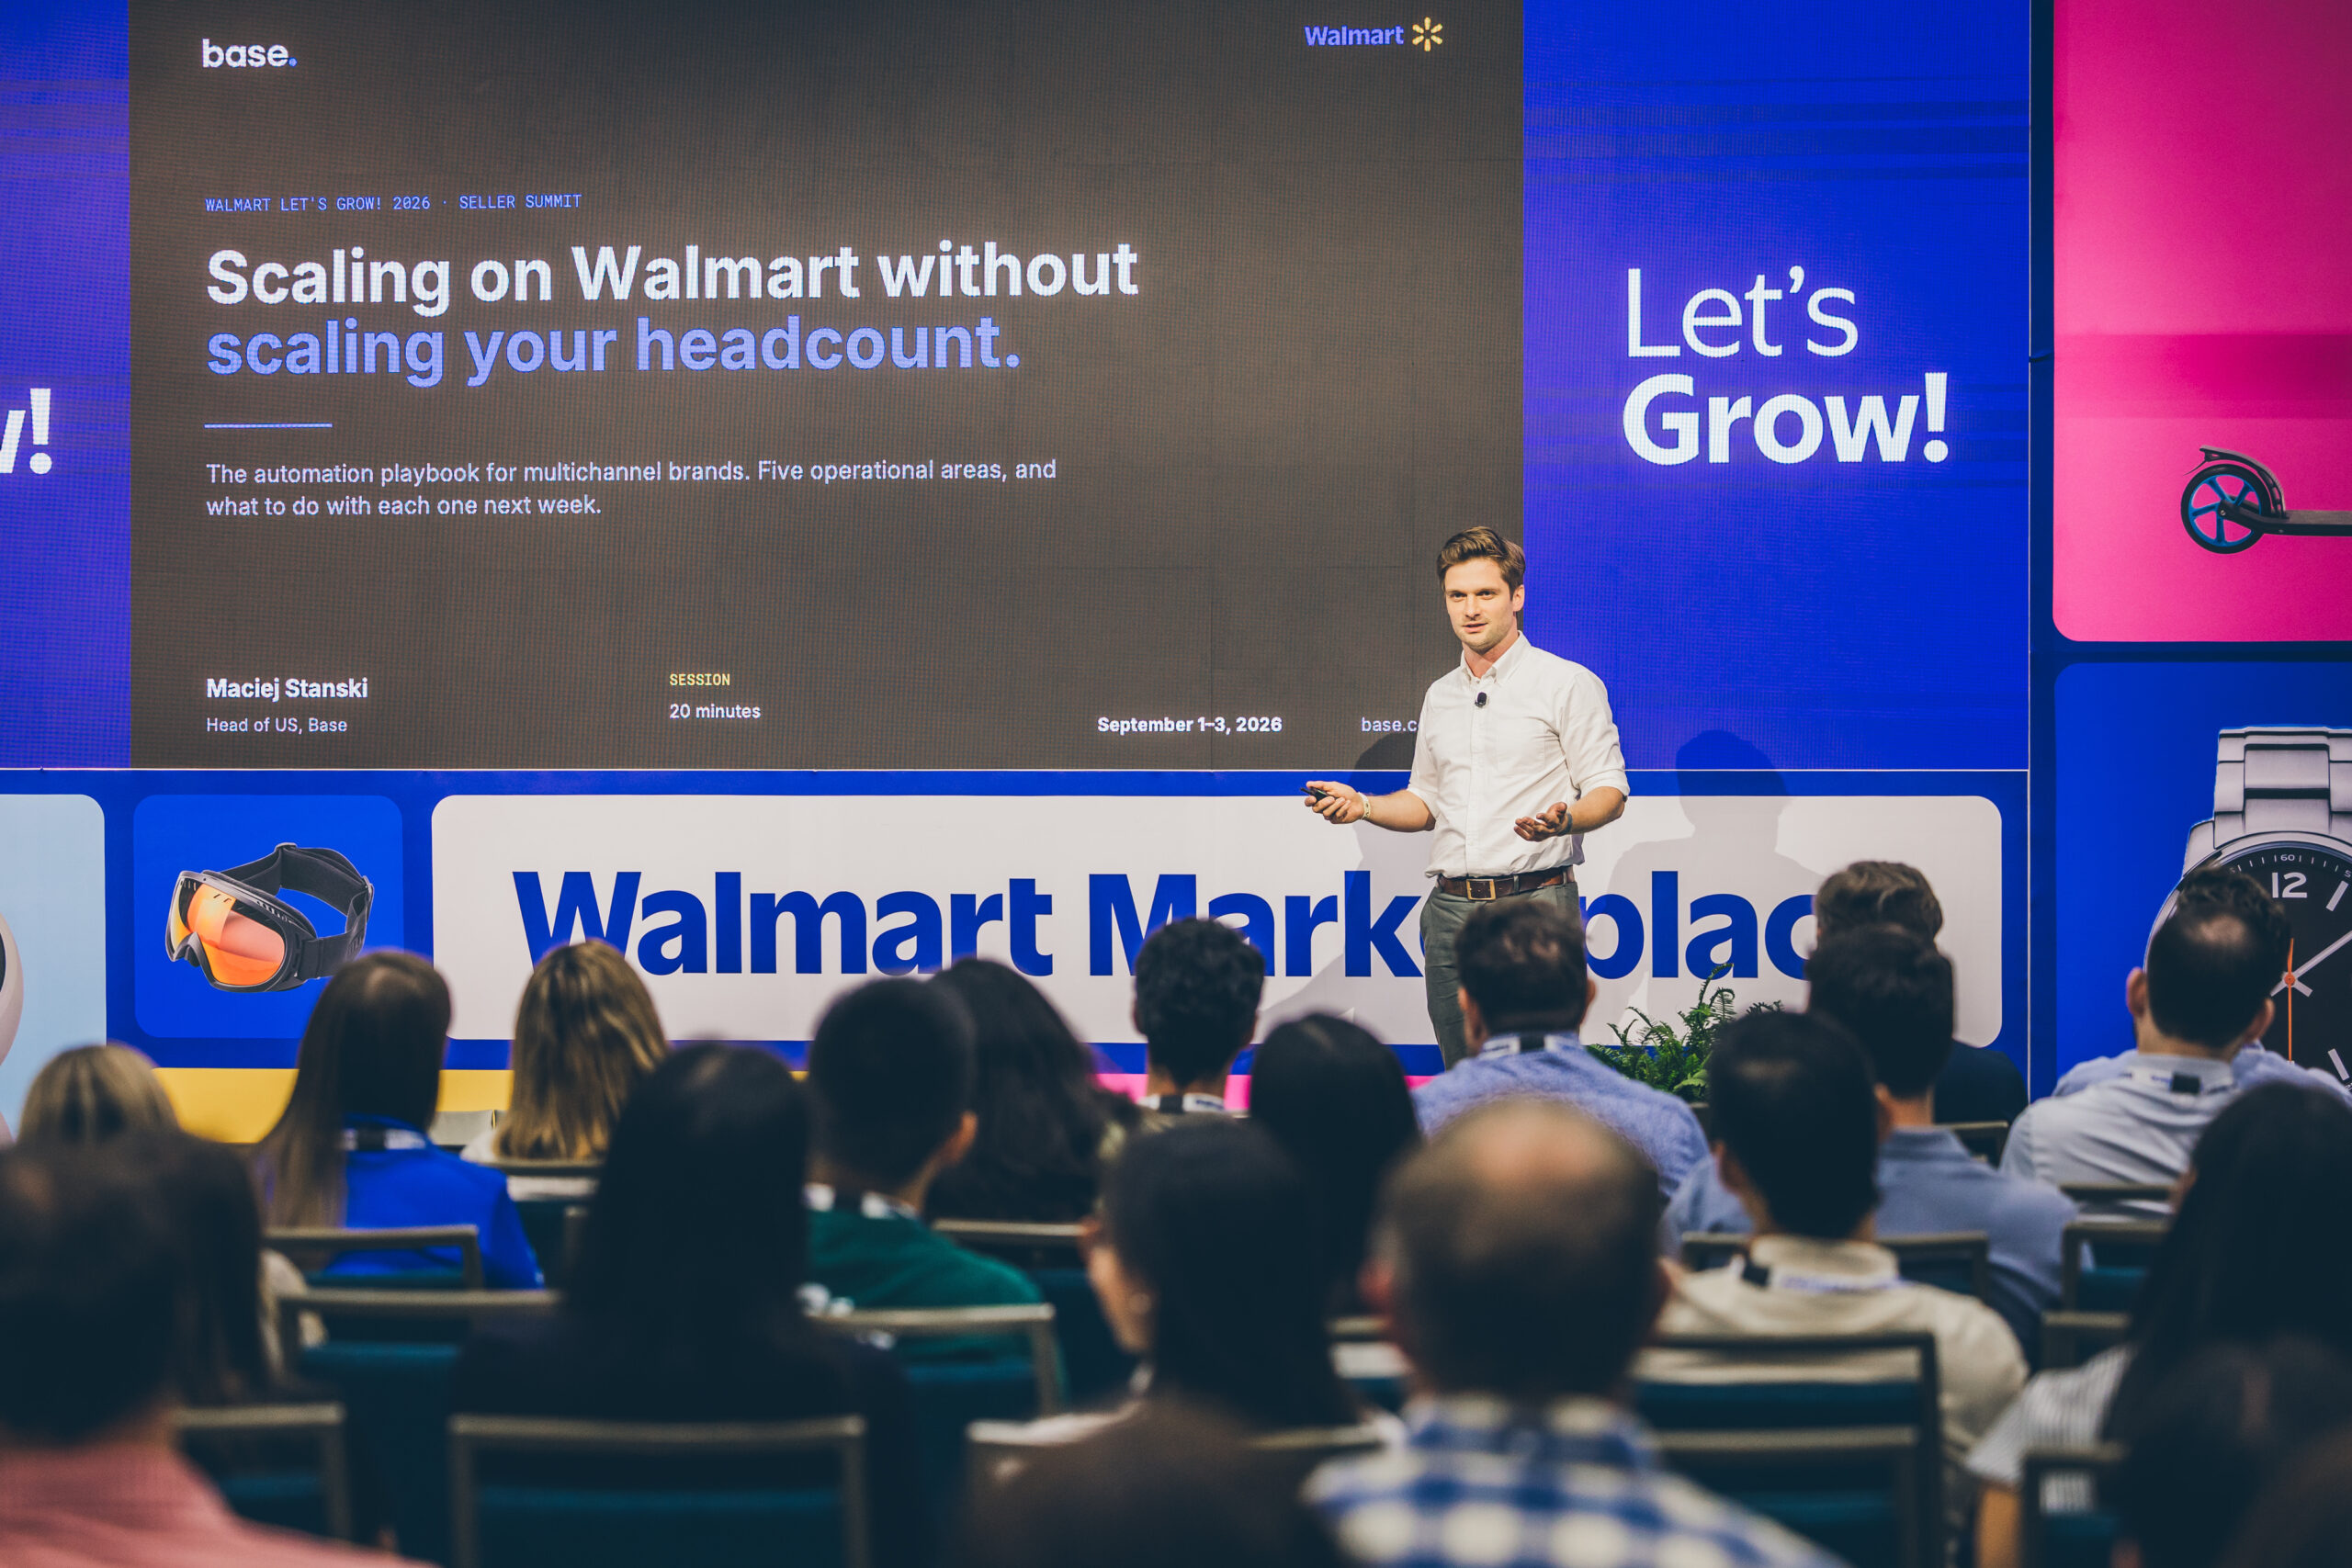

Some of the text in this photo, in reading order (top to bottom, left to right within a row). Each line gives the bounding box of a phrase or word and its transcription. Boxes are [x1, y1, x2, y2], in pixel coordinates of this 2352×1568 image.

[1304, 25, 1405, 47] Walmart
[201, 38, 298, 68] base.
[204, 197, 272, 212] WALMART
[279, 196, 328, 212] LET'S
[335, 196, 381, 211] GROW!
[392, 195, 431, 210] 2026
[458, 194, 516, 209] SELLER
[525, 193, 582, 209] SUMMIT
[207, 239, 1140, 318] Scaling on Walmart without
[207, 314, 1021, 389] scaling your headcount.
[1623, 372, 1949, 466] Grow!
[206, 458, 1057, 488] The automation playbook for multichannel brands. Five operational areas, and
[206, 493, 602, 516] what to do with each one next week.
[206, 677, 368, 704] Maciej Stanski
[670, 673, 730, 686] SESSION
[669, 703, 762, 719] 20 minutes
[206, 716, 348, 735] Head of US, Base
[1097, 716, 1194, 736] September
[1236, 716, 1283, 732] 2026
[2271, 871, 2308, 899] 12
[512, 871, 1053, 976] Walmart
